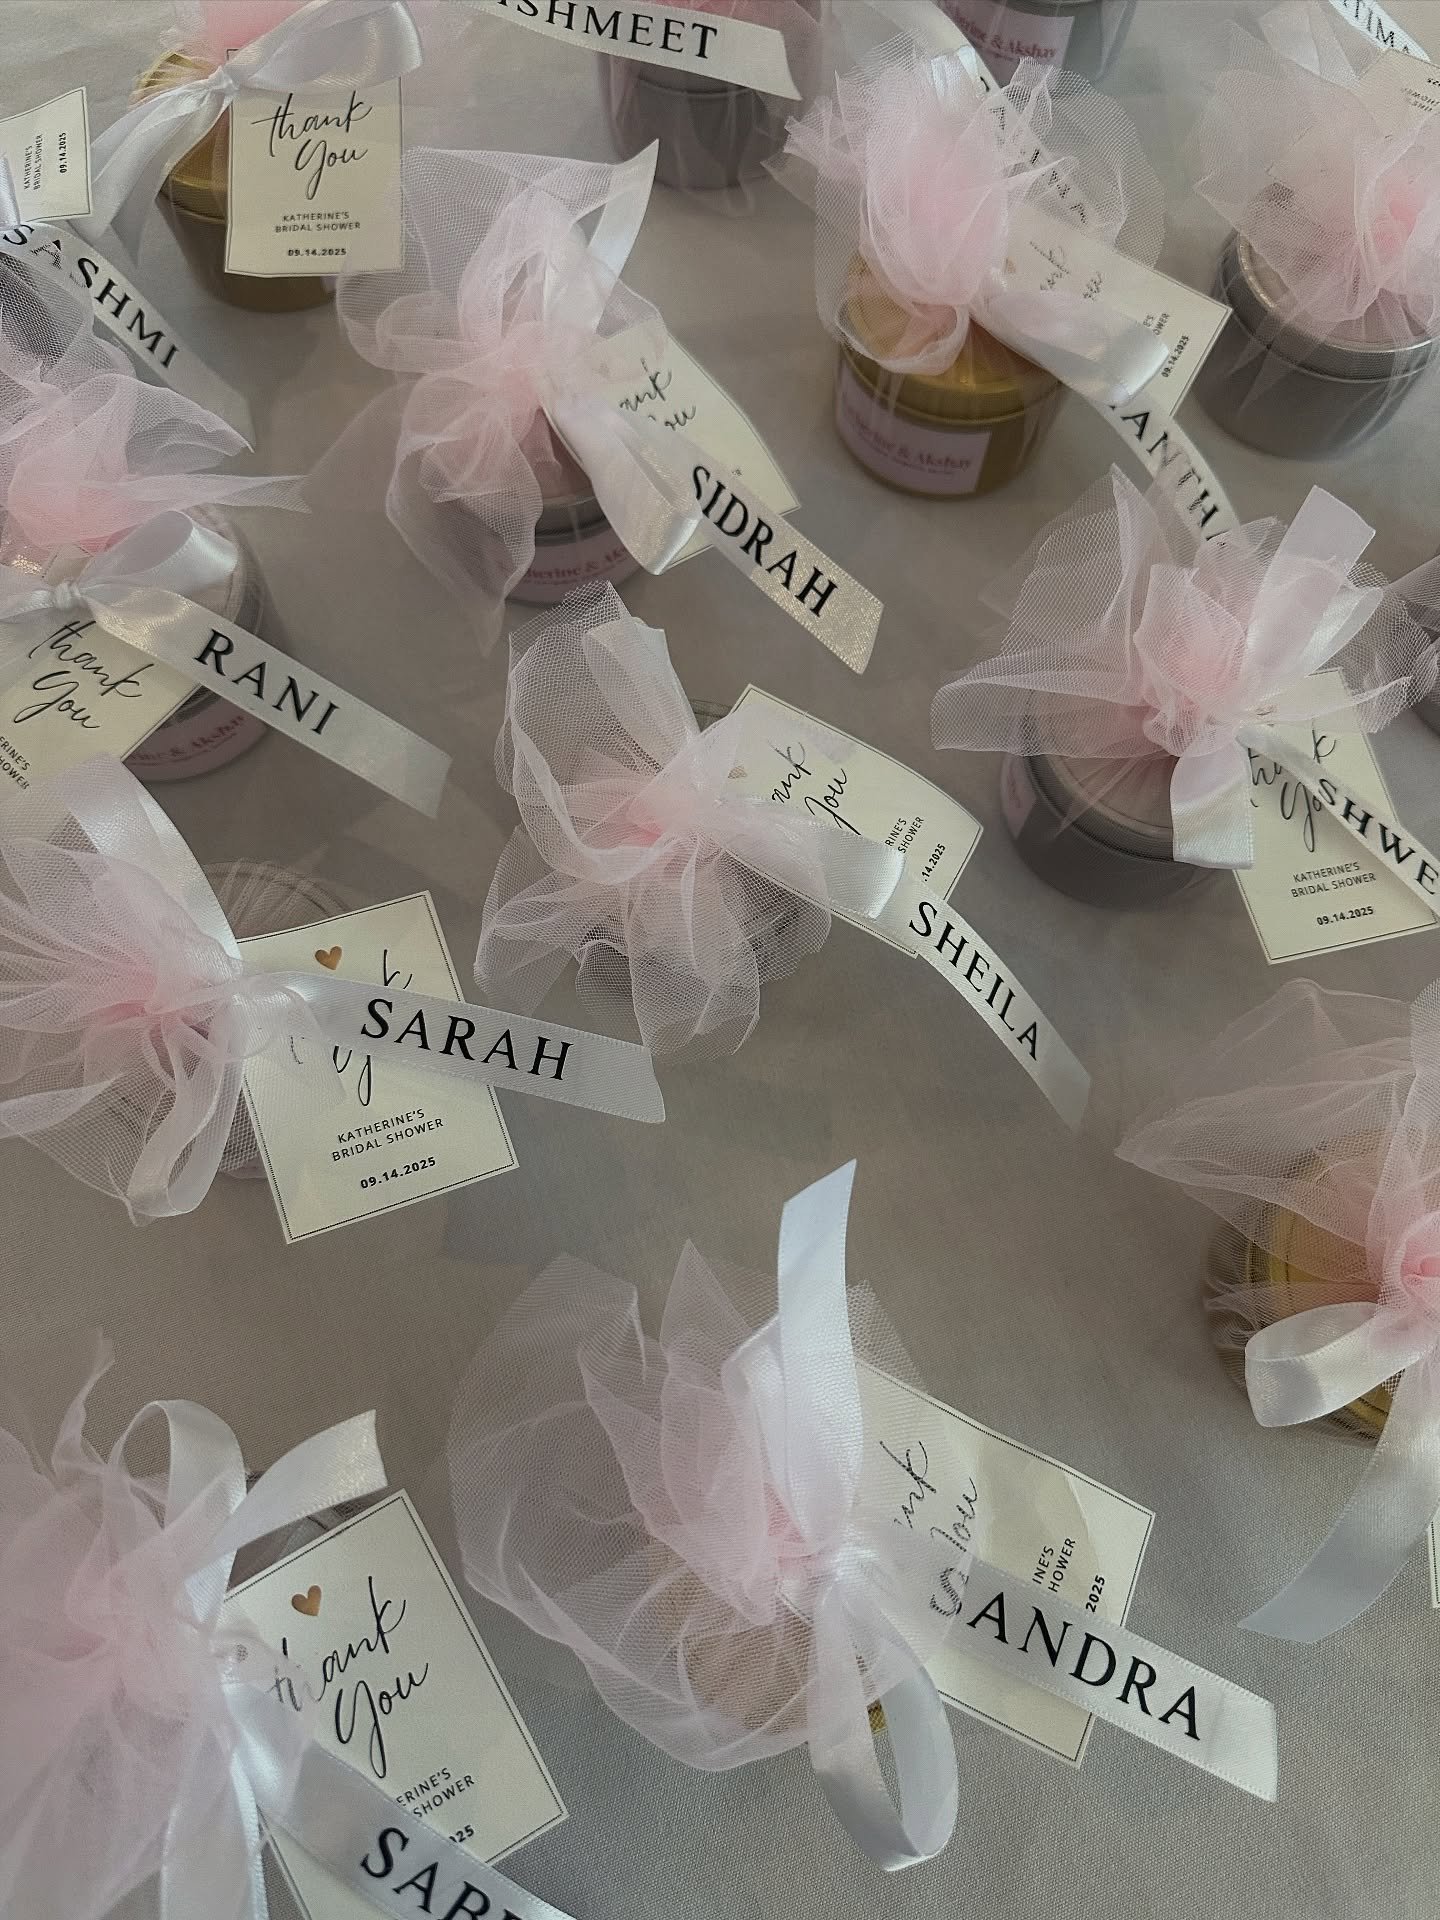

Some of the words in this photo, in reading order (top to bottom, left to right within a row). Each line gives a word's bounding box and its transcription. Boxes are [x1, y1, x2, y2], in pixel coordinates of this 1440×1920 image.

[497, 0, 718, 59] SHMEET
[251, 91, 372, 157] thank
[23, 144, 33, 190] KATHERINE'S
[35, 133, 44, 163] SHOWER
[58, 132, 68, 174] 09.14.2025
[295, 139, 369, 200] You
[33, 163, 42, 190] BRIDAL
[274, 222, 313, 234] BRIDAL
[315, 220, 361, 233] SHOWER
[281, 211, 351, 222] KATHERINE'S
[286, 247, 348, 257] 09.14.2025
[1160, 335, 1190, 378] 09.14.2025
[1109, 405, 1232, 547] ANTH
[691, 465, 839, 618] SIDRAH
[29, 620, 154, 698] thank
[14, 671, 101, 729] You
[194, 628, 340, 735] RANI
[897, 816, 925, 854] SHOWER
[1291, 882, 1330, 898] BRIDAL
[1331, 872, 1377, 892] SHOWER
[1292, 861, 1361, 884] KATHERINE'S
[1316, 905, 1375, 926] 09.14.2025
[908, 900, 1042, 1062] SHEILA
[361, 998, 575, 1082] SARAH
[331, 1136, 384, 1162] BRIDAL
[386, 1117, 444, 1145] SHOWER
[337, 1108, 426, 1144] KATHERINE'S
[360, 1156, 437, 1190] 09.14.2025
[1085, 1574, 1106, 1613] 2025
[929, 1565, 1201, 1741] SANDRA
[335, 1662, 429, 1779] You
[413, 1774, 475, 1818] SHOWER
[360, 1827, 523, 1920] SAB
